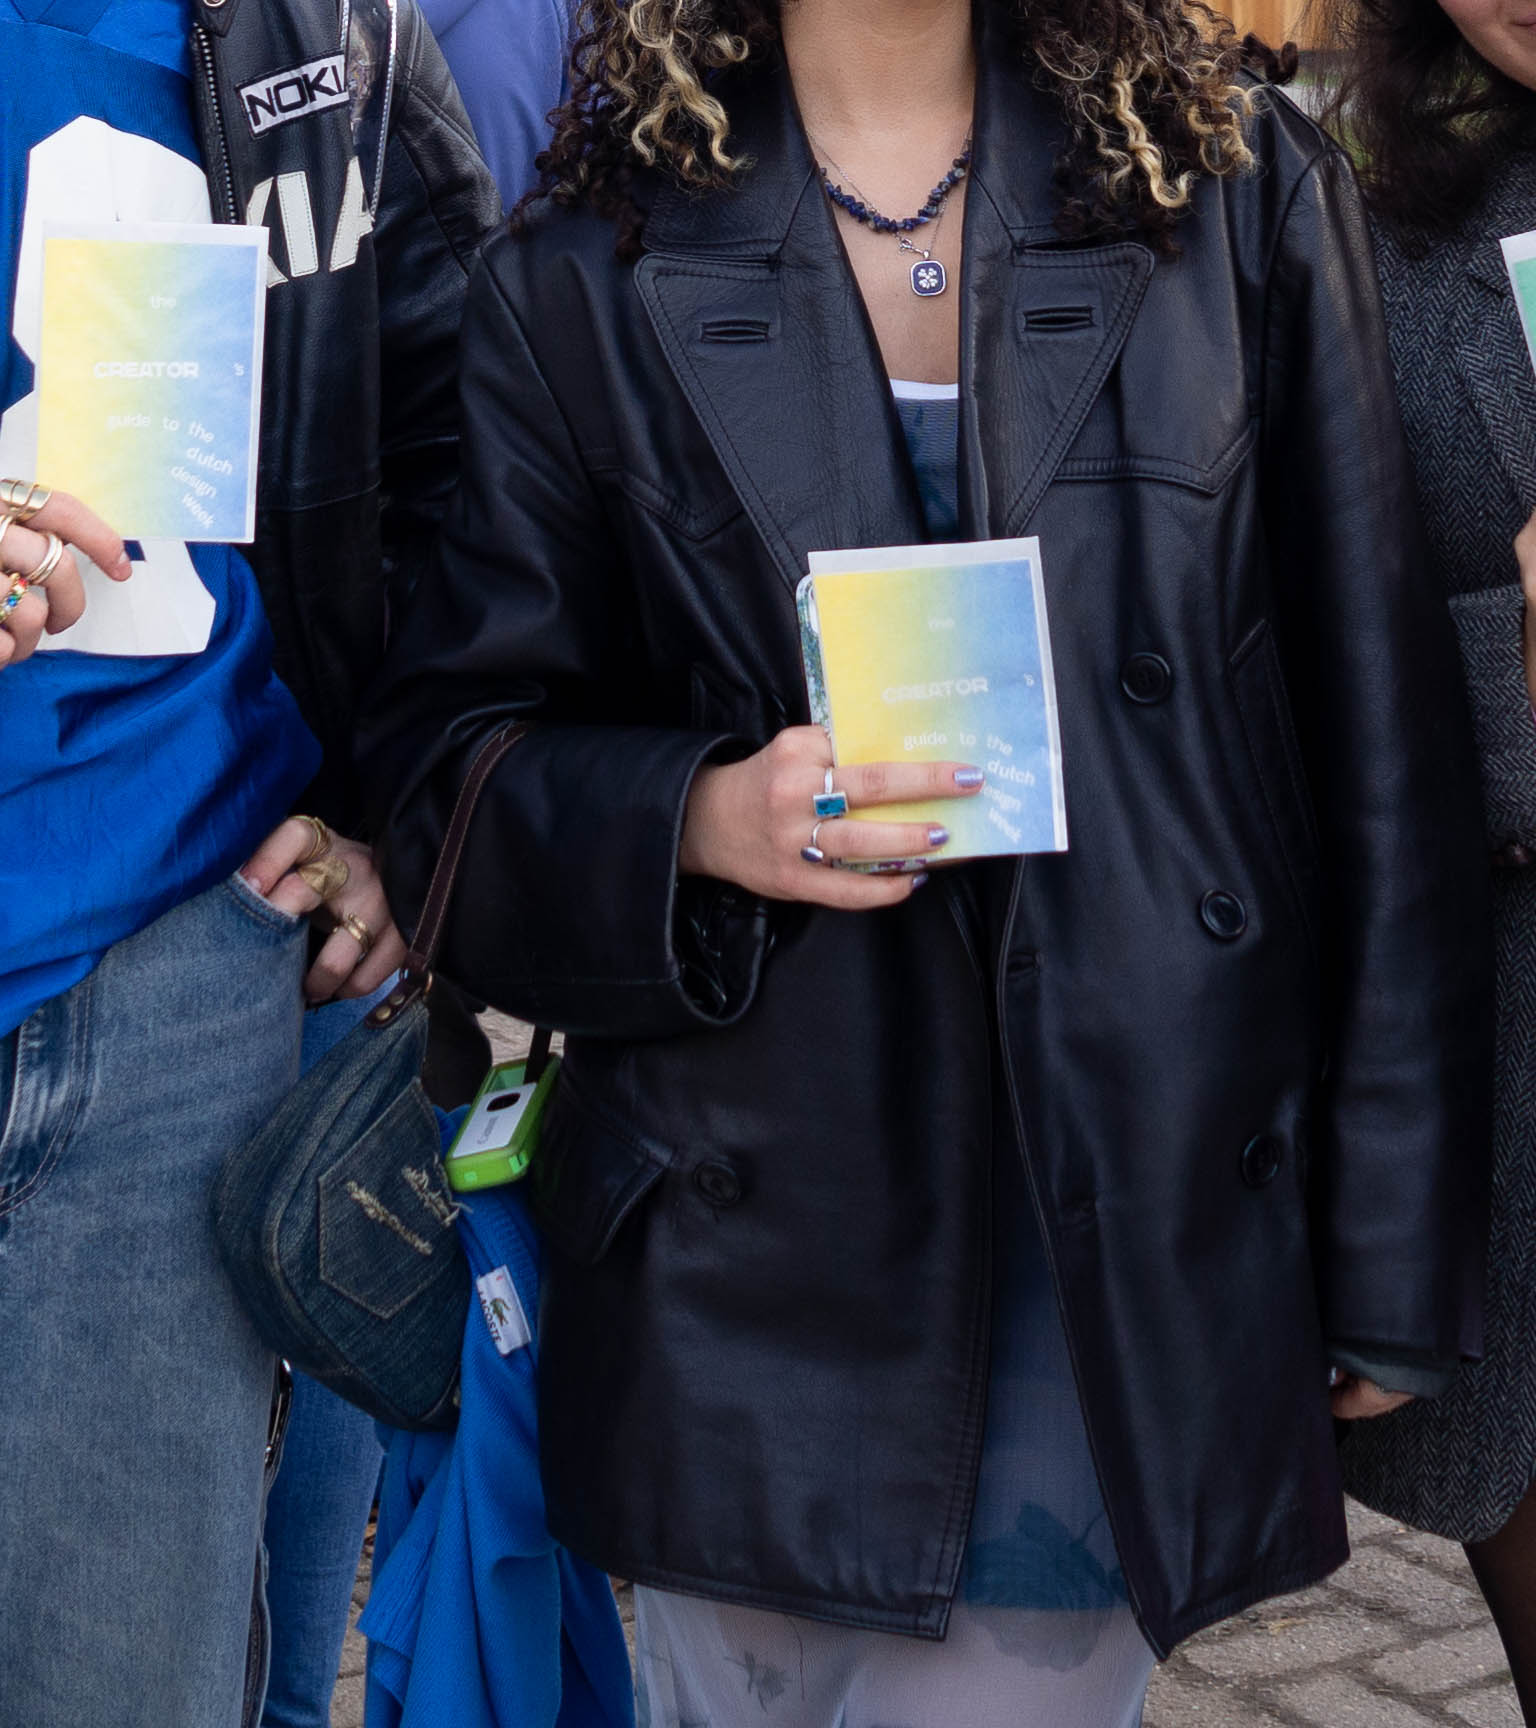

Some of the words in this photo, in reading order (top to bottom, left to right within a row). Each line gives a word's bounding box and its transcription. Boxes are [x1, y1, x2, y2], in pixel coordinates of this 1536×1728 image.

[245, 65, 347, 127] NOKI
[150, 294, 177, 309] the
[93, 361, 199, 380] CREATOR
[107, 413, 151, 432] guide
[162, 416, 181, 432] to
[188, 421, 215, 443] the
[186, 445, 233, 475] dutch
[170, 465, 217, 498] design
[181, 494, 214, 529] week
[882, 677, 989, 705] CREATOR
[903, 731, 948, 752] guide
[959, 732, 977, 746] to
[986, 734, 1013, 756] the
[987, 760, 1036, 787] dutch
[980, 783, 1022, 811] esign
[477, 1291, 502, 1343] LACOSTE
